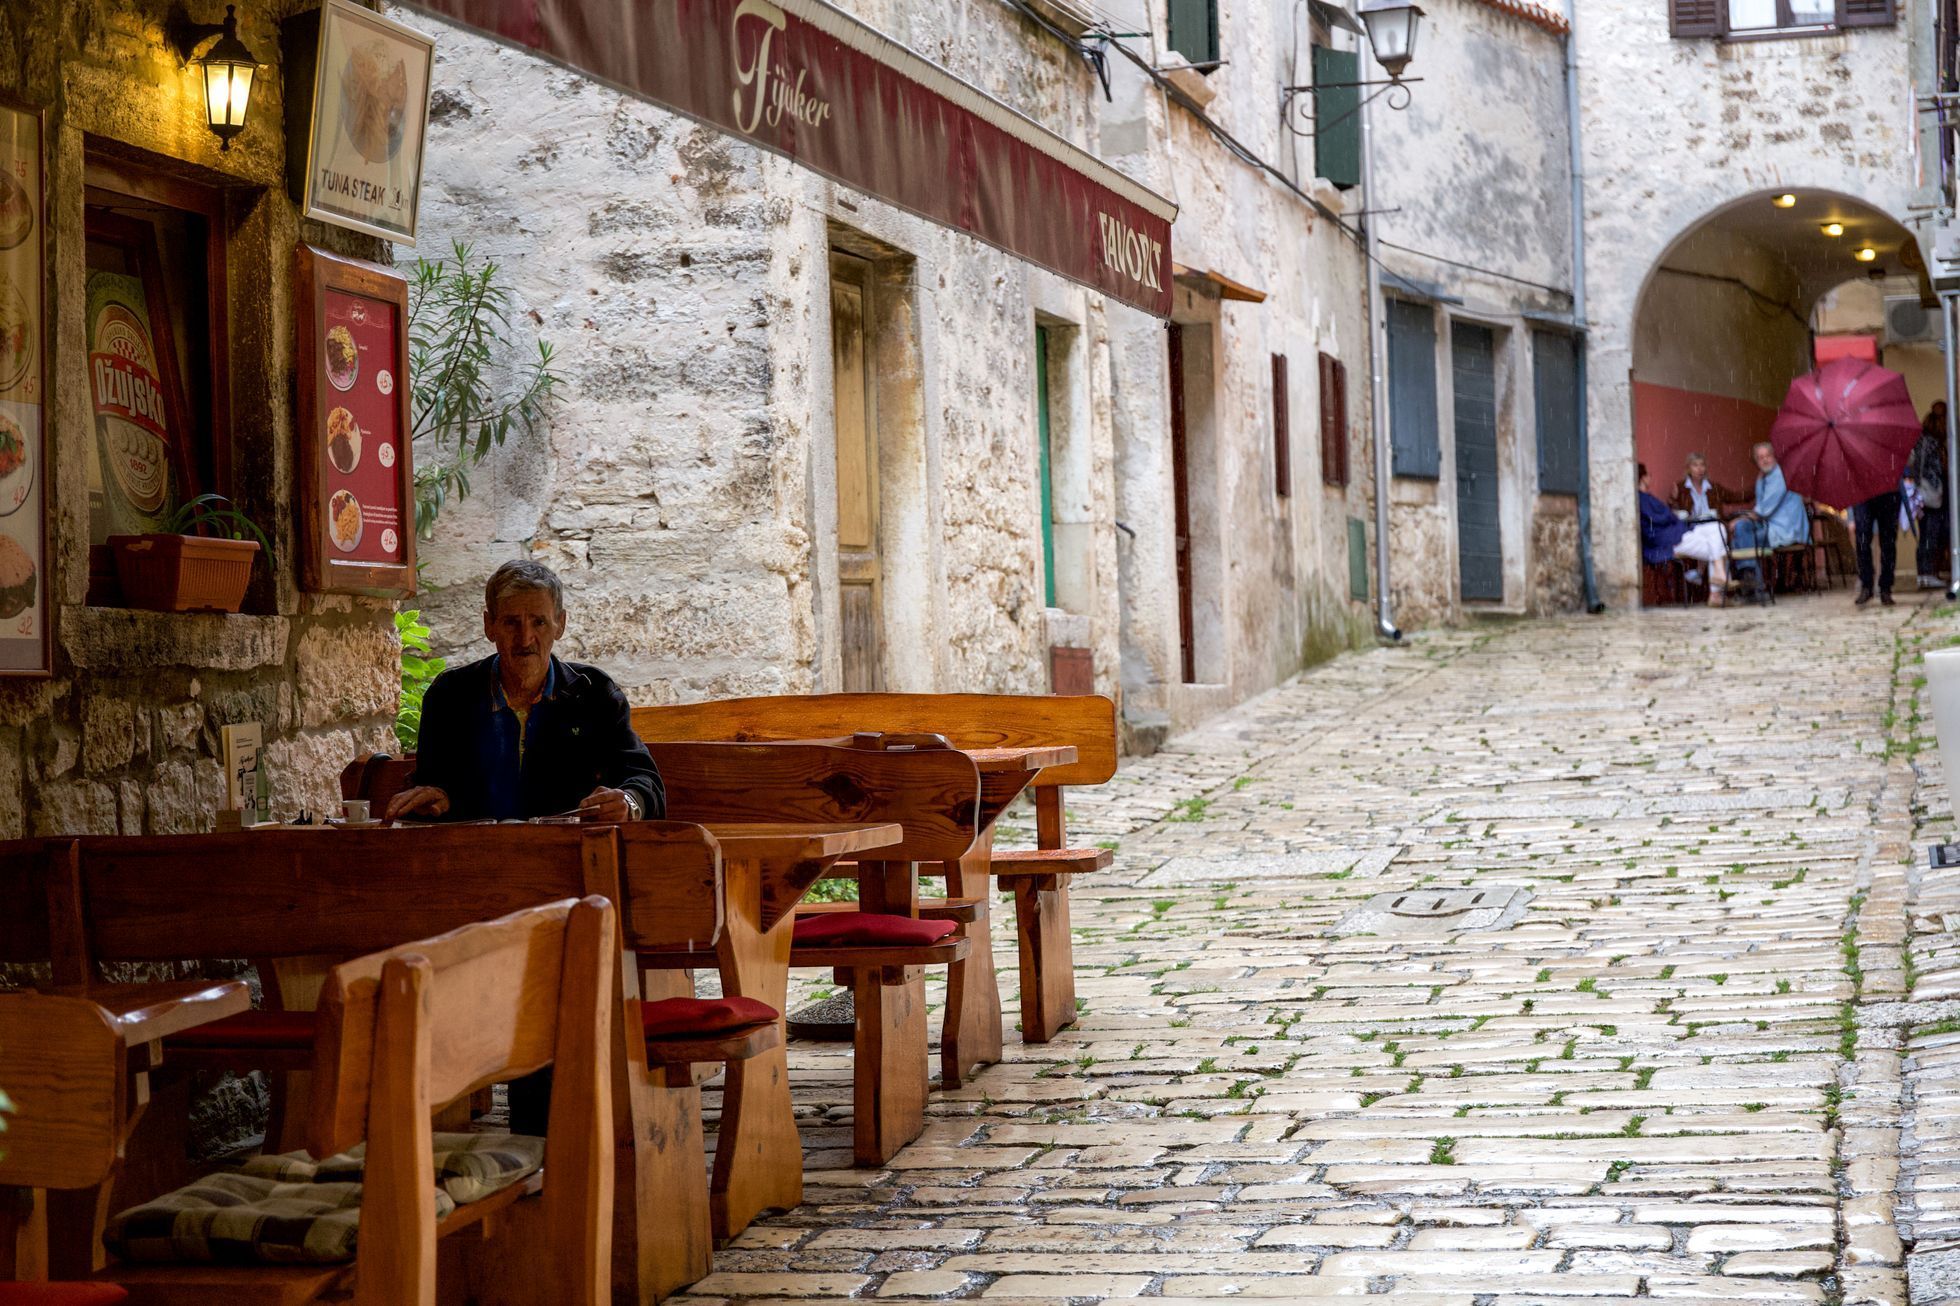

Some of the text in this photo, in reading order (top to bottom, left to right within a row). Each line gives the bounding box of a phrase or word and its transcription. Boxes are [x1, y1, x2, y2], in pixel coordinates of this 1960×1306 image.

[321, 168, 349, 196] TUNA
[351, 178, 386, 206] STEAK
[1099, 211, 1164, 293] FAVORIT
[23, 376, 36, 394] 45
[94, 358, 167, 430] Ožujsko
[129, 458, 148, 475] 1892
[17, 615, 33, 636] 32
